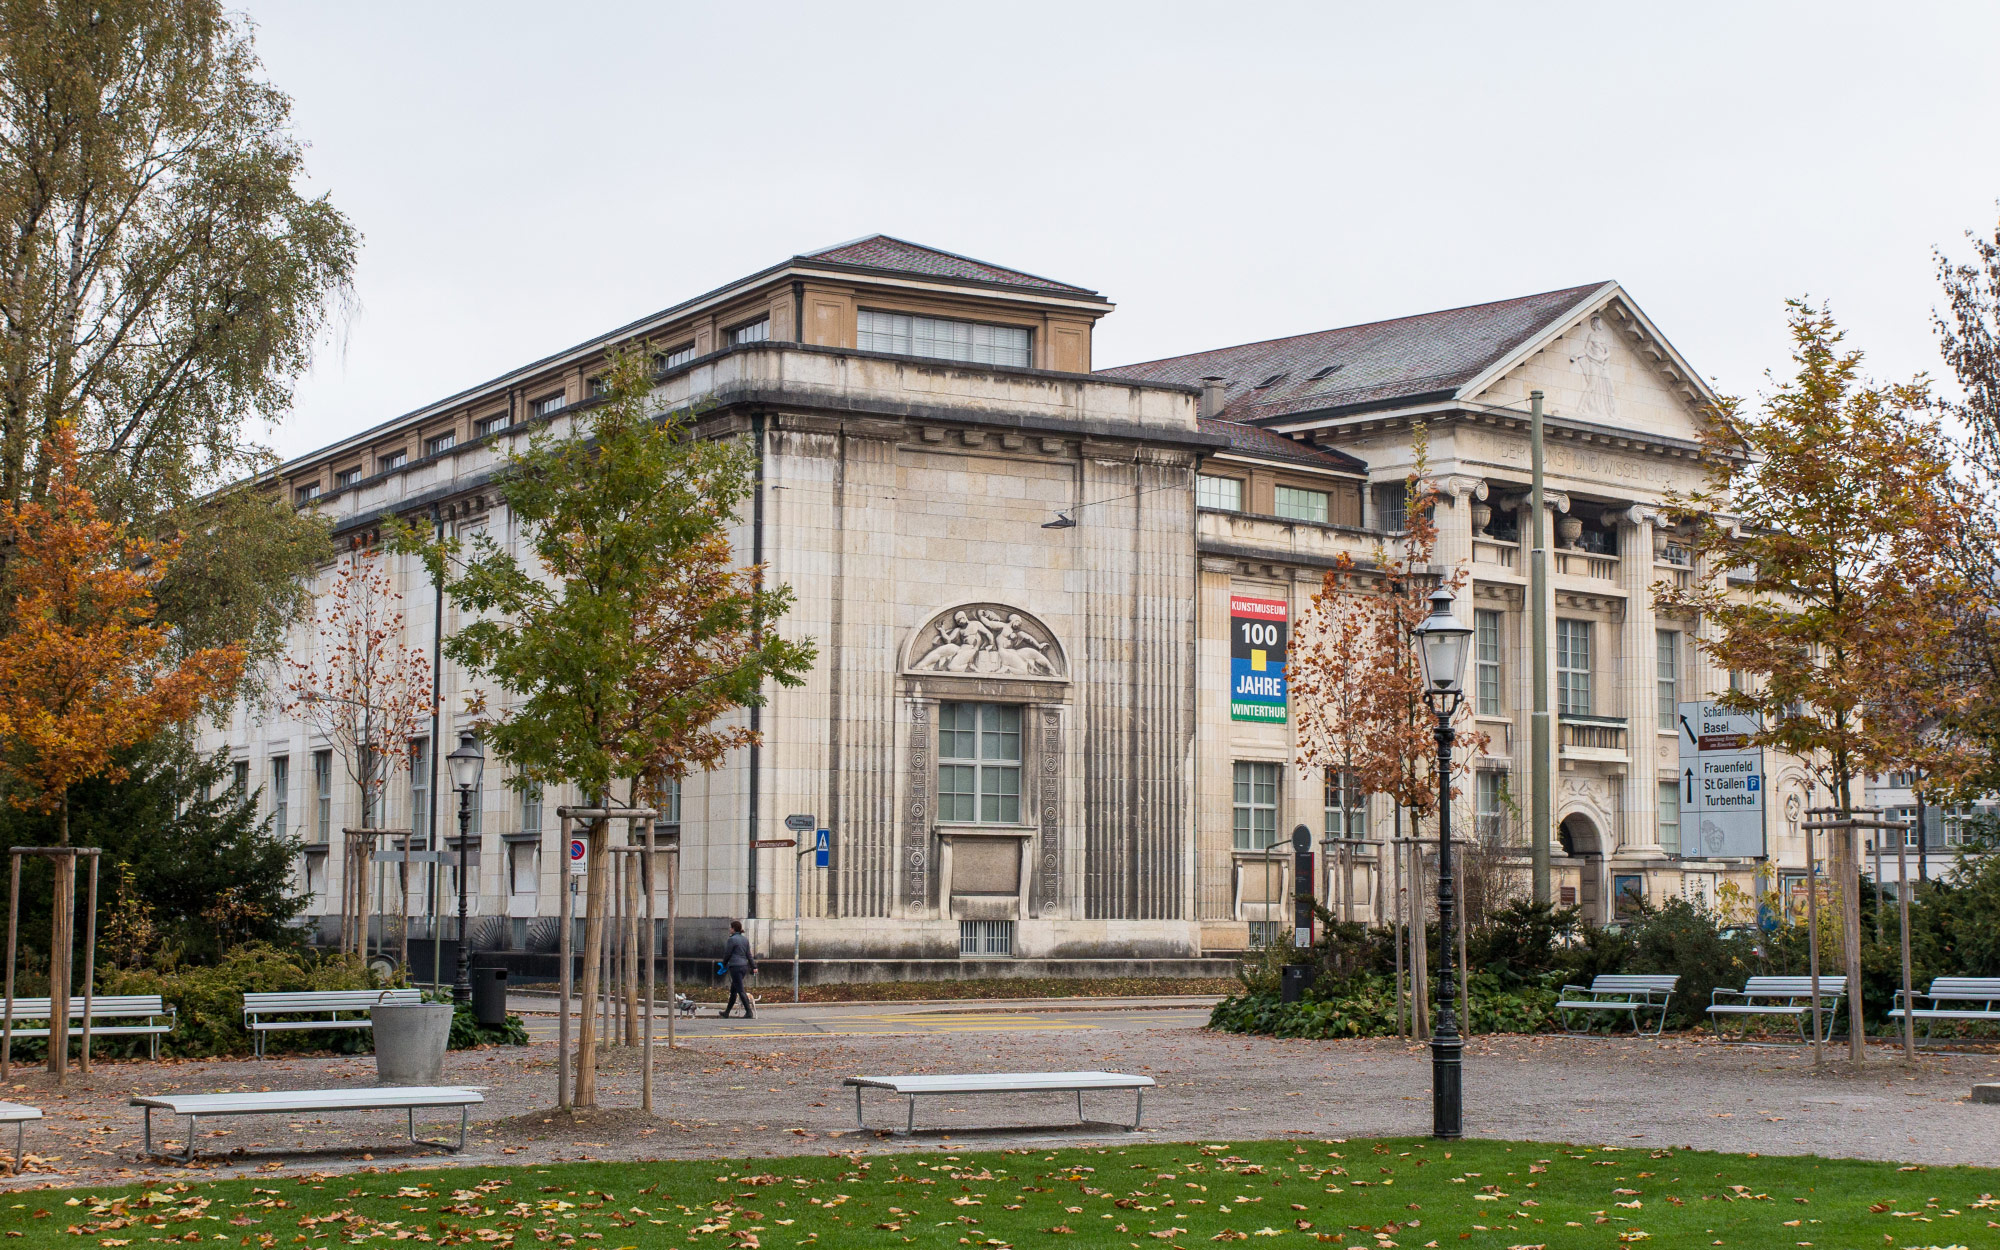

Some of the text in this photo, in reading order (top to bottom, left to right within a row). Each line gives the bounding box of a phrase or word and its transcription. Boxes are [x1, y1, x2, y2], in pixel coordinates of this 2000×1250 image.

[1501, 442, 1527, 461] DER
[1574, 453, 1599, 474] UND
[1231, 600, 1286, 616] KUNSTMUSEUM
[1241, 622, 1278, 646] 100
[1236, 675, 1281, 697] JAHRE
[1231, 703, 1286, 718] WINTERTHUR
[1703, 720, 1729, 733] Basel
[1704, 761, 1753, 774] Frauenfeld
[1705, 793, 1755, 806] Turbenthal
